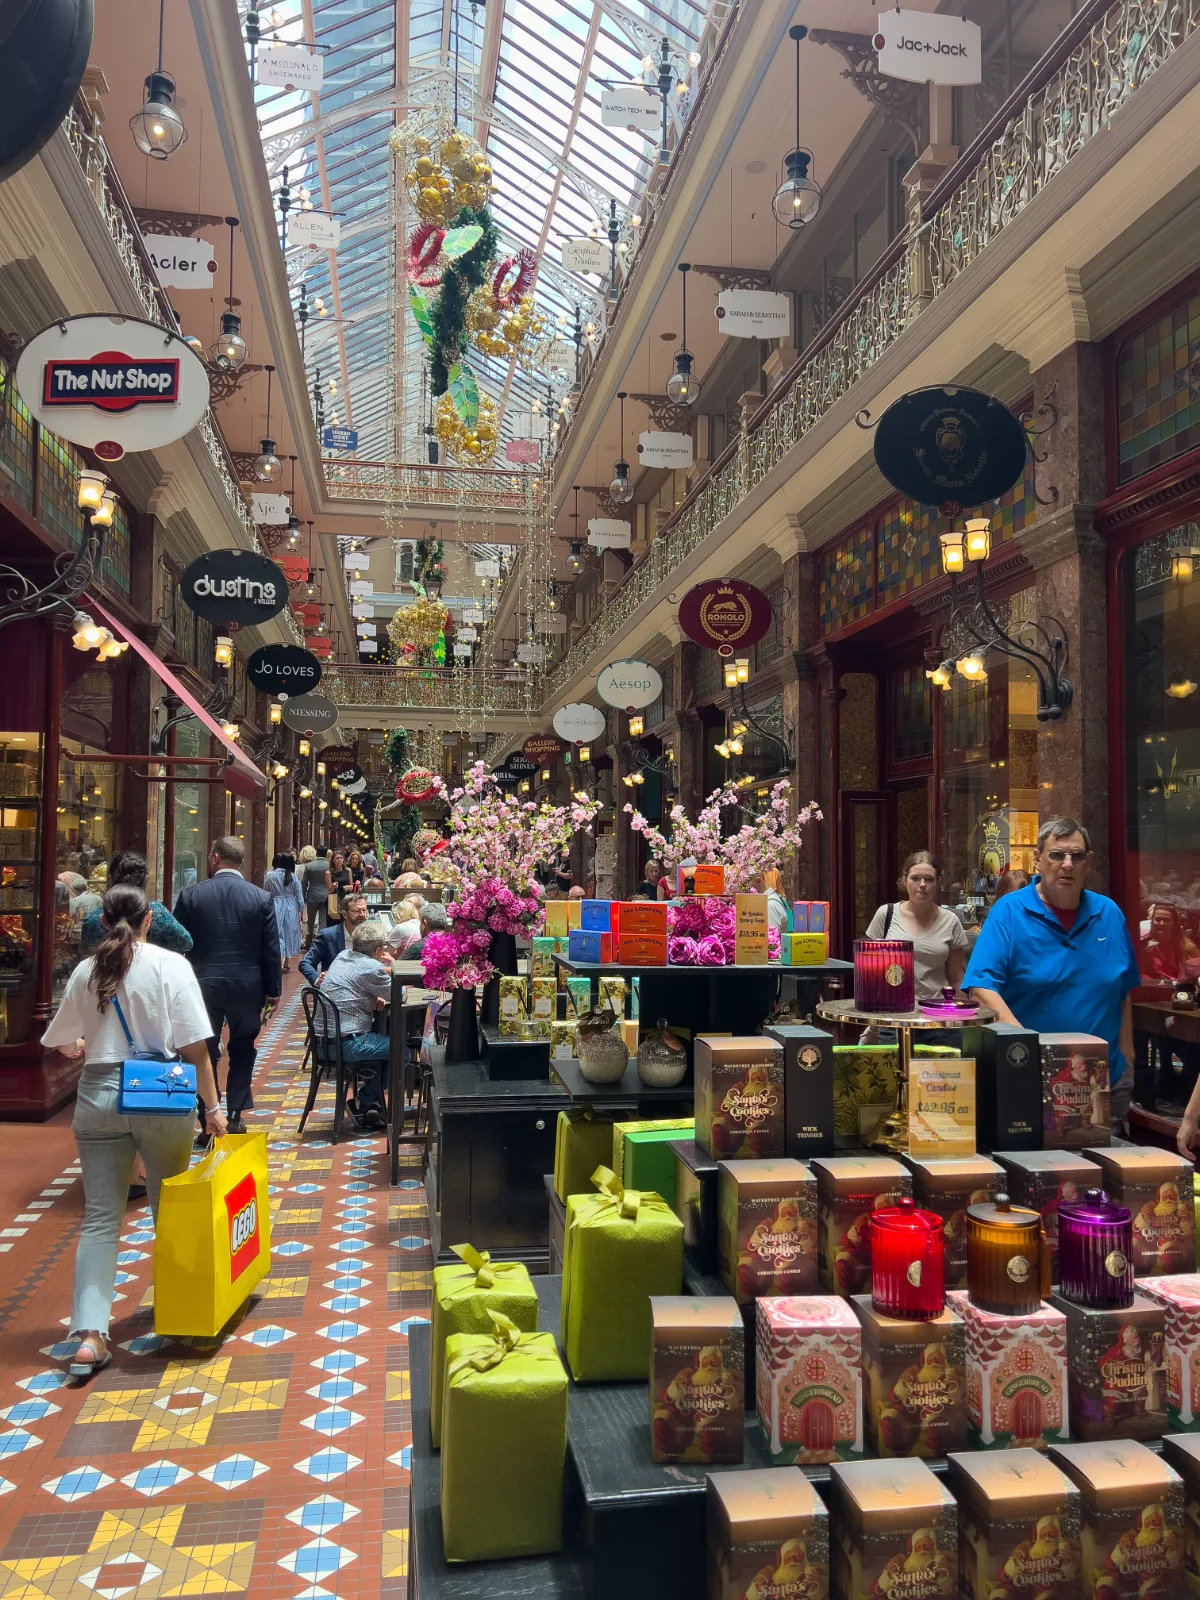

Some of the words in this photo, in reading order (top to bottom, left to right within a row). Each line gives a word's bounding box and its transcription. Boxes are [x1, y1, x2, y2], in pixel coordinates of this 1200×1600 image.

[896, 35, 968, 57] Jac+Jack
[268, 69, 312, 82] SHOEMAKER
[292, 221, 325, 232] ALLEN
[54, 369, 89, 391] The
[91, 369, 124, 390] Nut
[125, 368, 172, 393] Shop
[101, 444, 117, 456] 25
[932, 474, 965, 488] Maria
[254, 501, 278, 516] Aje.
[945, 502, 960, 513] 26
[193, 574, 276, 599] dustins
[707, 613, 745, 621] ROMOLO
[229, 622, 239, 630] 23
[255, 659, 273, 674] Jo
[276, 665, 315, 677] LOVES
[608, 678, 652, 693] Aesop
[289, 708, 332, 719] NIESSING
[524, 745, 561, 753] SHOPPING
[527, 739, 557, 747] GALLERY
[634, 907, 663, 915] LONDON
[578, 934, 598, 943] LONDON
[634, 938, 664, 946] LONDON
[802, 938, 824, 946] LONDON
[727, 1089, 776, 1107] Santa's
[915, 1101, 956, 1115] $42.95
[957, 1105, 969, 1114] ea
[232, 1200, 256, 1254] LEGO
[1139, 1225, 1184, 1239] Cookies
[755, 1229, 805, 1246] Santa's
[904, 1379, 950, 1395] Santa's
[1004, 1379, 1051, 1397] GINGERBREAD
[792, 1388, 842, 1406] GINGERBREAD
[902, 1395, 953, 1409] Cookies
[674, 1397, 728, 1413] Cookies
[1119, 1543, 1165, 1561] Santa's
[1014, 1553, 1062, 1571] Santa's
[1117, 1557, 1167, 1575] Cookies
[886, 1567, 938, 1586] Santa's
[1011, 1571, 1064, 1589] Cookies
[756, 1580, 809, 1599] Santa's
